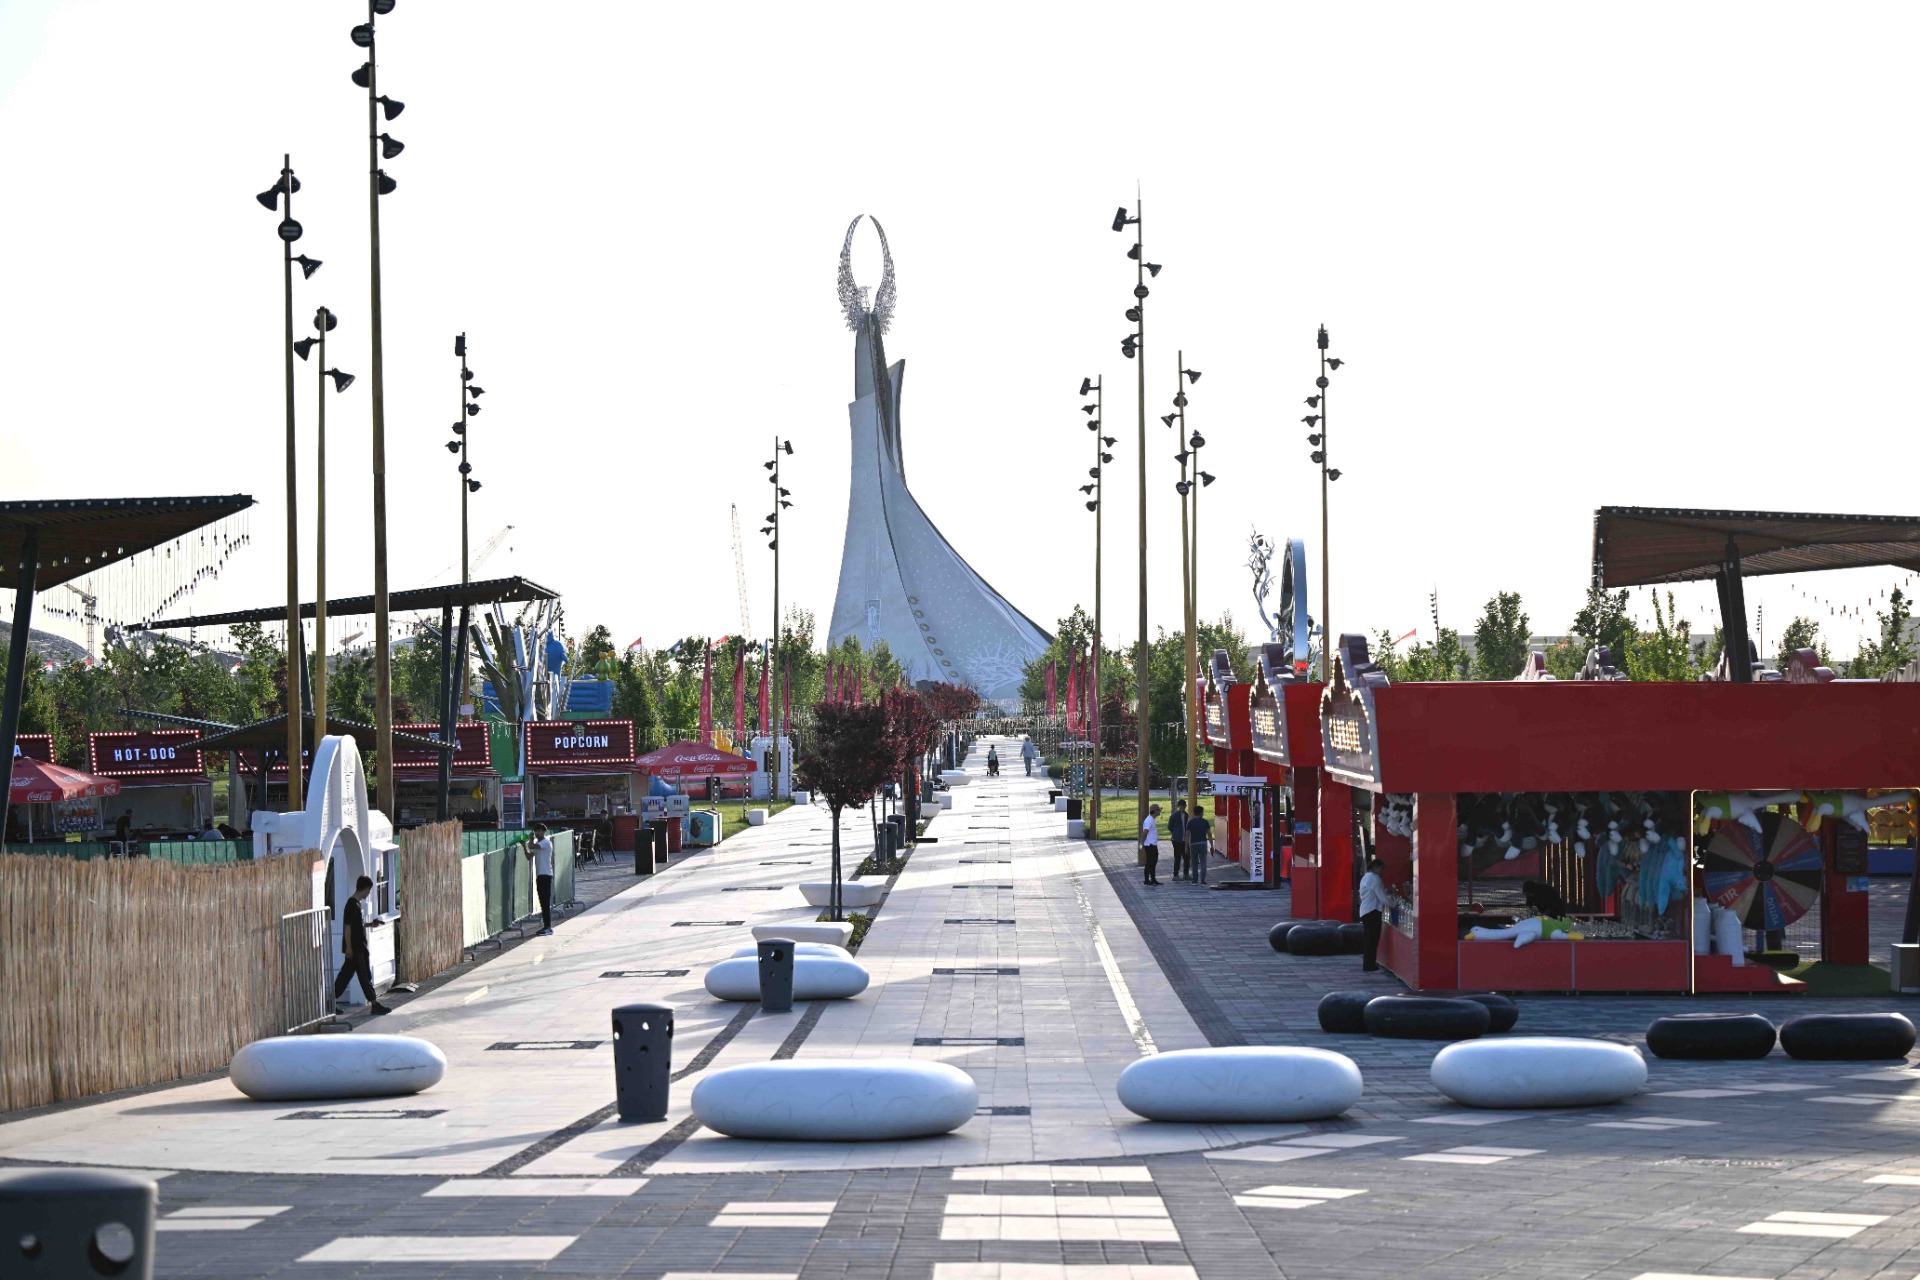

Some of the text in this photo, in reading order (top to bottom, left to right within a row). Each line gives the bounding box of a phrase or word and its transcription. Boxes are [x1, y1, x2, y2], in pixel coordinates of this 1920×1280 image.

[555, 735, 608, 748] POPCORN
[114, 747, 176, 761] HOT-DOG
[1718, 888, 1739, 904] TIR
[1767, 897, 1779, 926] YUTUQ
